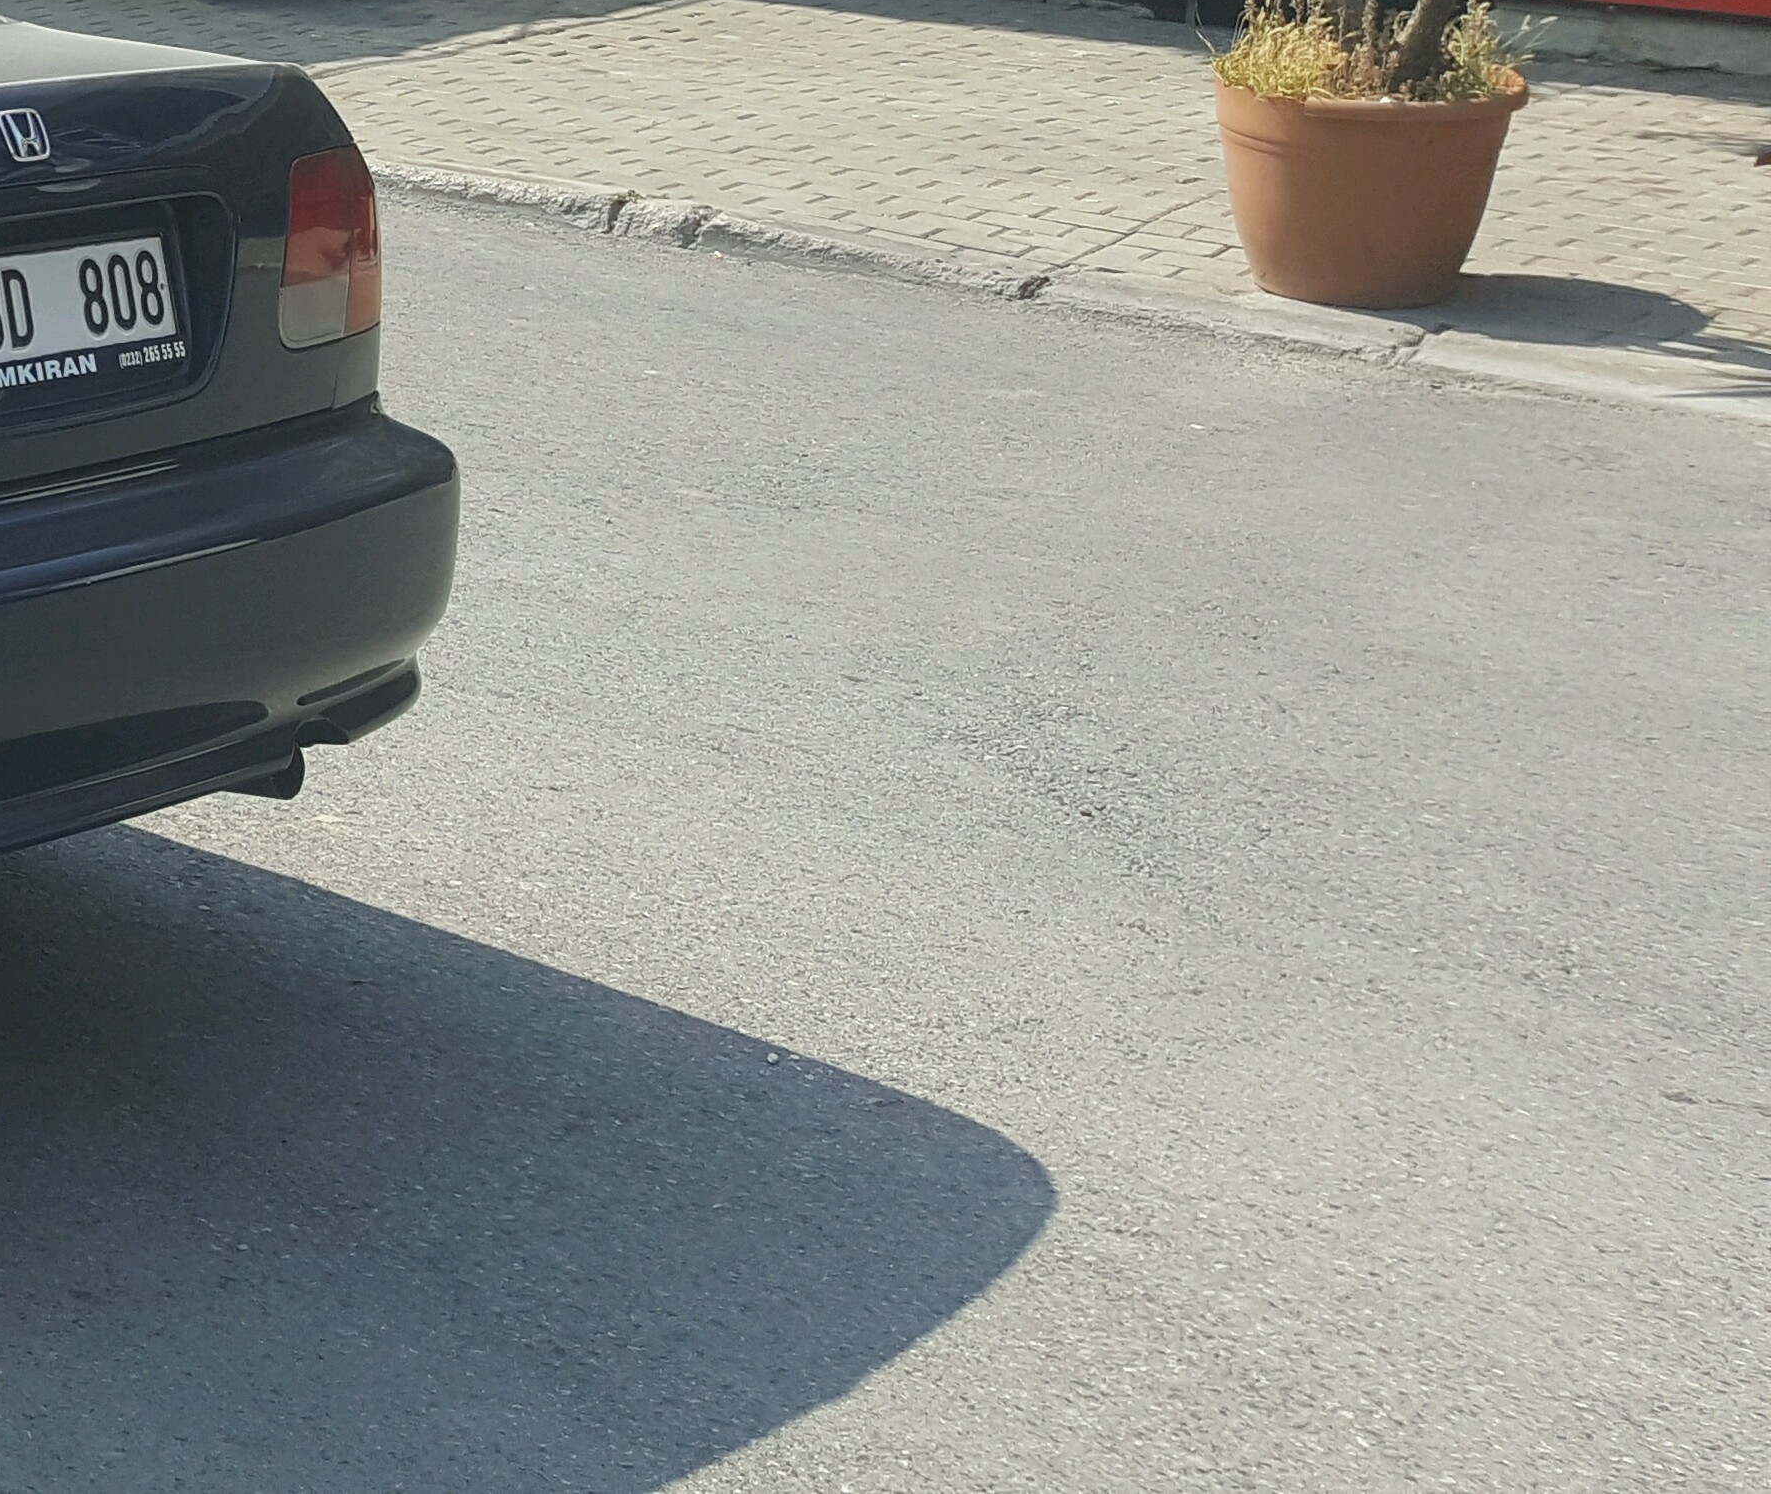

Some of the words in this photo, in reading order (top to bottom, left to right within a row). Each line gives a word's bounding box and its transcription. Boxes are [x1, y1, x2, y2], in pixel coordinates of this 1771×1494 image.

[78, 249, 166, 336] 808
[118, 349, 144, 369] (0232)
[144, 345, 161, 364] 265
[161, 343, 174, 361] 55
[173, 340, 187, 358] 55
